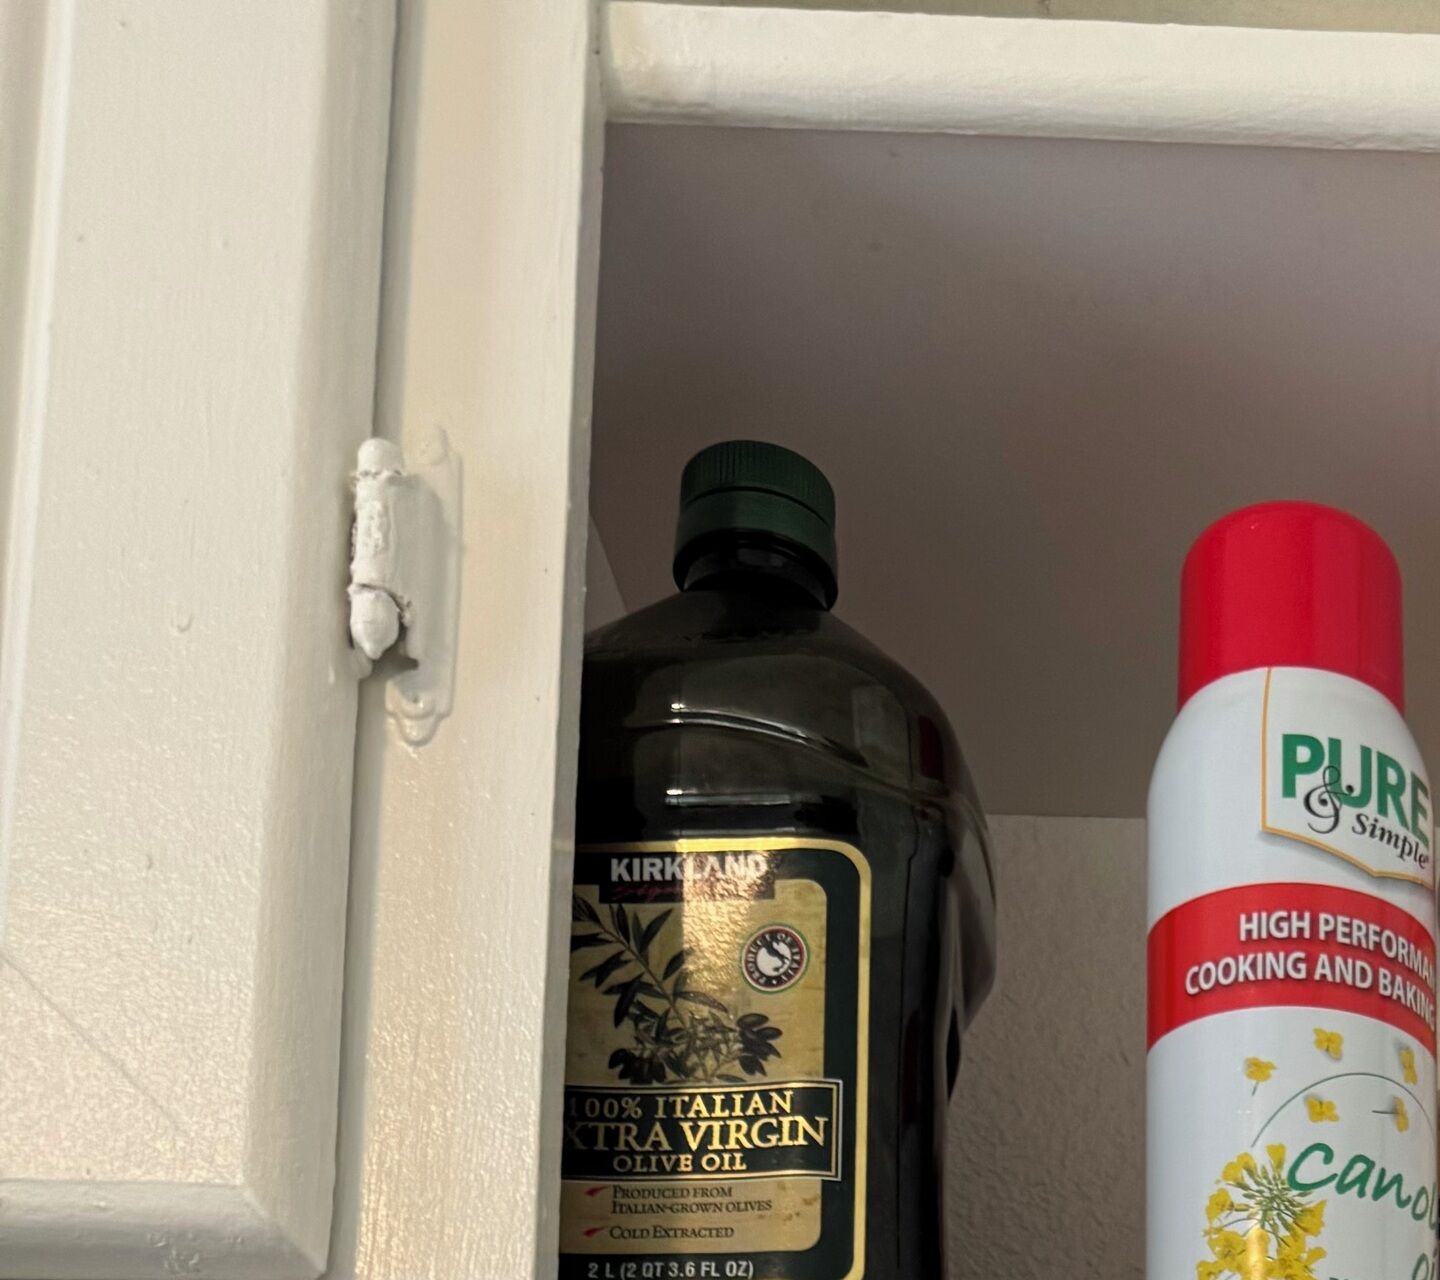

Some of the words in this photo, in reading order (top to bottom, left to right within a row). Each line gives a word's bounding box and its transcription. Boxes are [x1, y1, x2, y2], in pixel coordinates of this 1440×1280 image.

[1281, 733, 1430, 850] PURE
[1351, 811, 1429, 870] Simple
[610, 854, 767, 883] KIRKLAND
[1239, 910, 1311, 942] HIGH
[1185, 951, 1308, 996] COOKING
[1314, 953, 1373, 989] AND
[655, 1090, 795, 1117] ITALIAN
[564, 1122, 673, 1151] XTRA
[680, 1116, 828, 1151] VIRGIN
[613, 1154, 693, 1173] OLIVE
[701, 1152, 748, 1171] OIL
[587, 1263, 600, 1278] 2
[604, 1263, 615, 1278] L
[620, 1262, 636, 1280] (2
[641, 1262, 664, 1279] QT
[668, 1262, 695, 1278] 3.6
[700, 1261, 721, 1278] FL
[725, 1260, 755, 1280] OZ)
